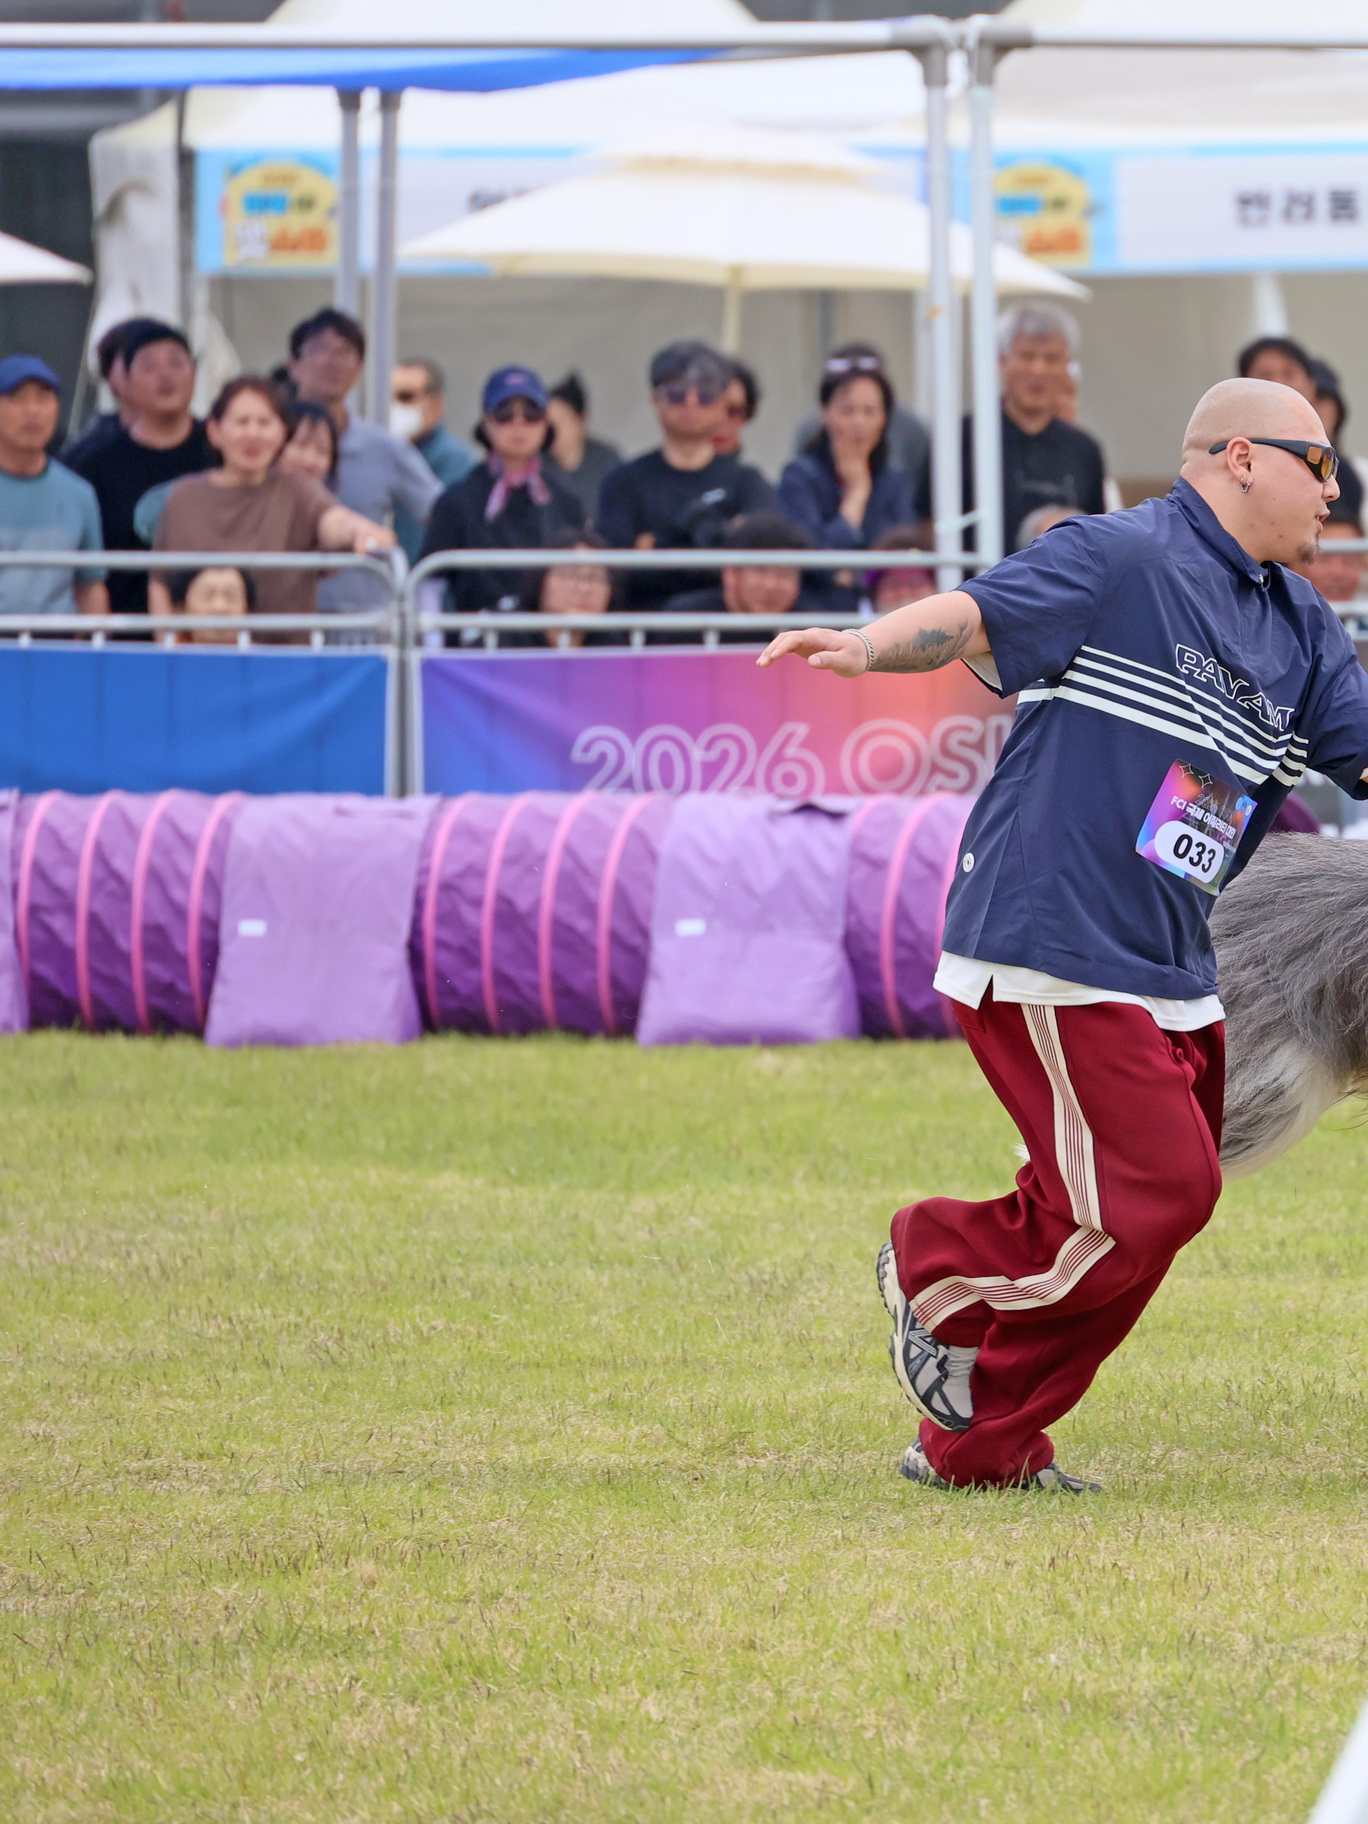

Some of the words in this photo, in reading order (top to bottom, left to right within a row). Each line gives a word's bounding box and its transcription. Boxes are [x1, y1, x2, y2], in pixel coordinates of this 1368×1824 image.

[570, 721, 826, 797] 2026
[1170, 795, 1188, 810] FCI
[1186, 802, 1206, 821] 국제
[1202, 812, 1228, 834] 어질리티
[1172, 833, 1217, 874] 033
